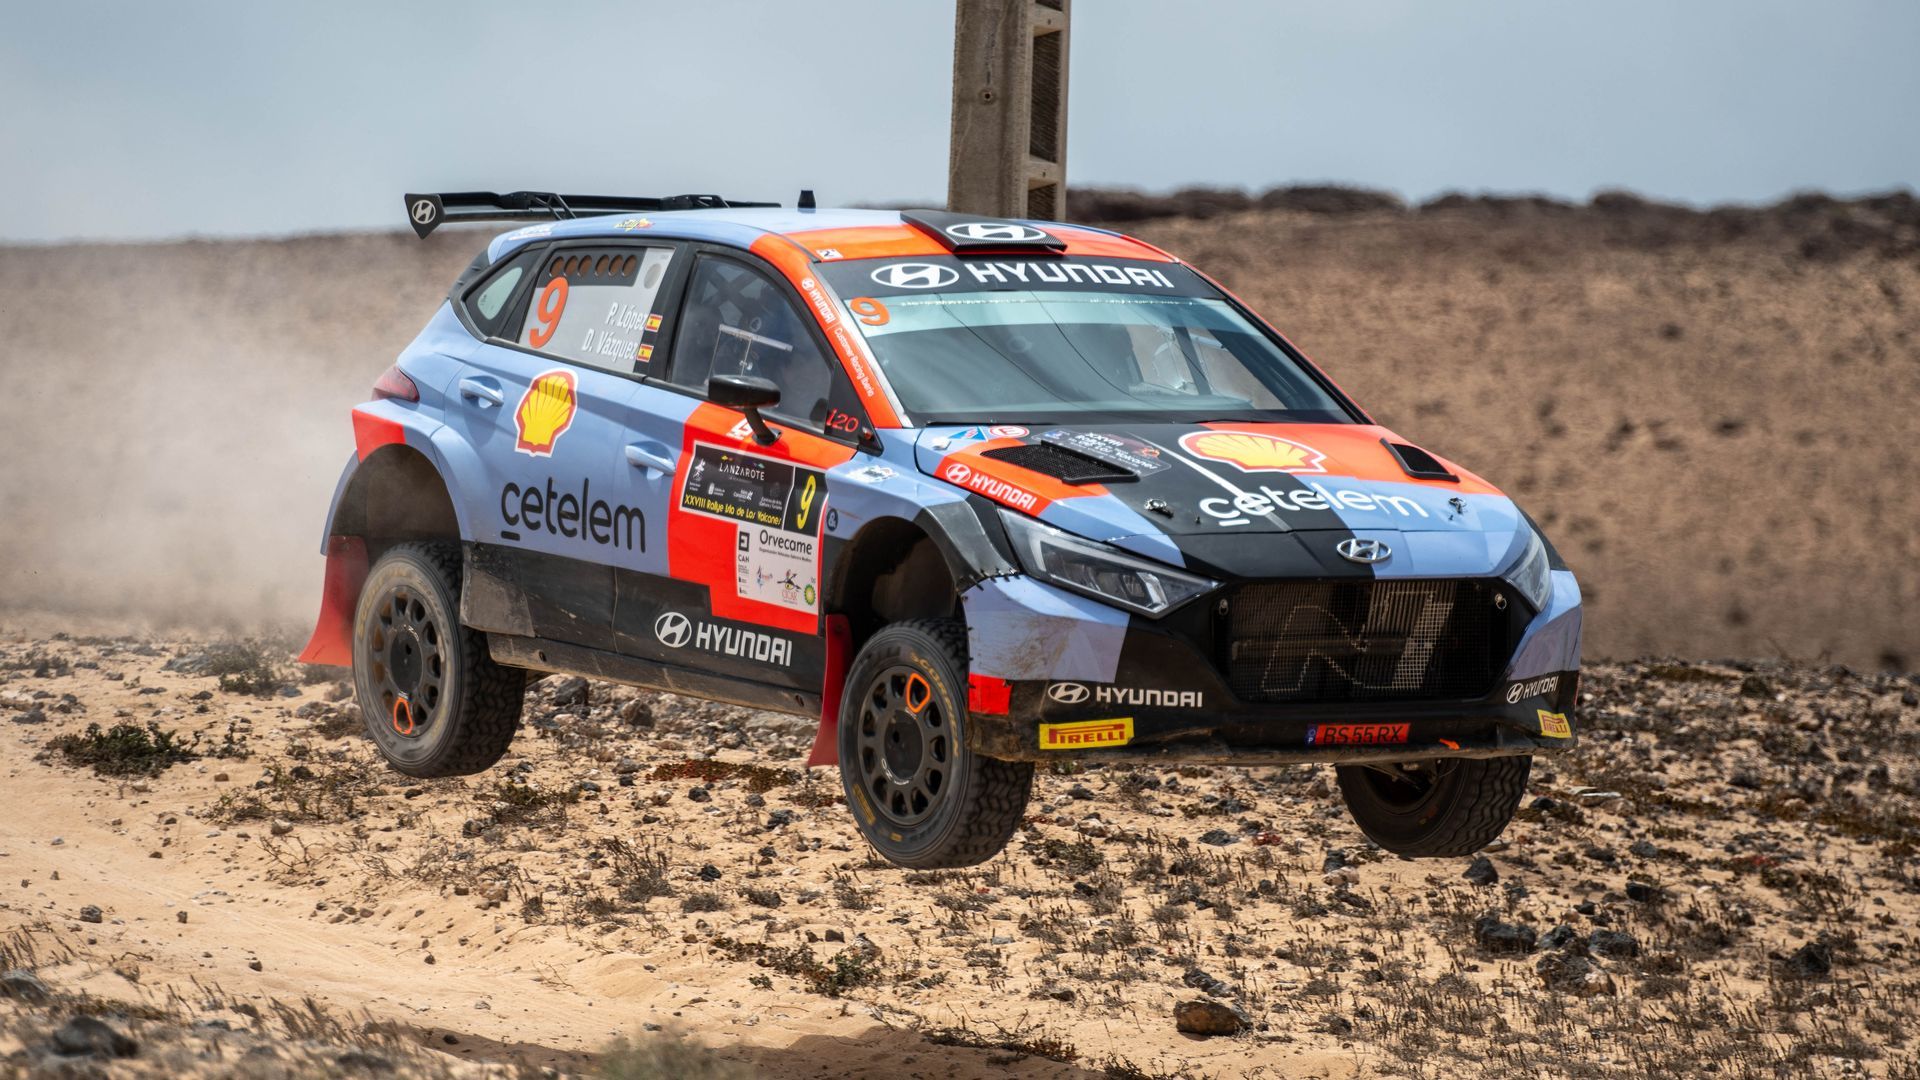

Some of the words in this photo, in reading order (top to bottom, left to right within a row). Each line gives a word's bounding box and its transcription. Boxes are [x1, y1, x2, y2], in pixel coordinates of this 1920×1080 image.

[963, 261, 1175, 288] HYUNDAI
[529, 276, 569, 349] 9
[605, 302, 619, 326] P.
[616, 304, 650, 334] López
[809, 288, 837, 324] HYUNDAI
[850, 297, 890, 326] 9
[581, 328, 595, 352] D.
[596, 331, 640, 361] Vázquez
[719, 462, 766, 481] LANZAROTE
[796, 474, 816, 530] 9
[969, 473, 1037, 510] HYUNDAI
[1199, 482, 1430, 526] cetelem
[501, 476, 646, 554] cetelem
[684, 493, 706, 508] XXVIII
[706, 497, 725, 513] Rallye
[736, 506, 745, 517] de
[746, 508, 756, 520] Los
[759, 529, 813, 555] Orvecame
[695, 622, 793, 667] HYUNDAI
[1096, 686, 1203, 708] HYUNDAI
[1522, 675, 1560, 700] HYUNDAI
[1048, 723, 1126, 744] PIRELLI
[1324, 726, 1349, 744] BS
[1352, 726, 1376, 744] 55
[1377, 725, 1403, 744] RX
[1541, 714, 1568, 734] PIRELLI
